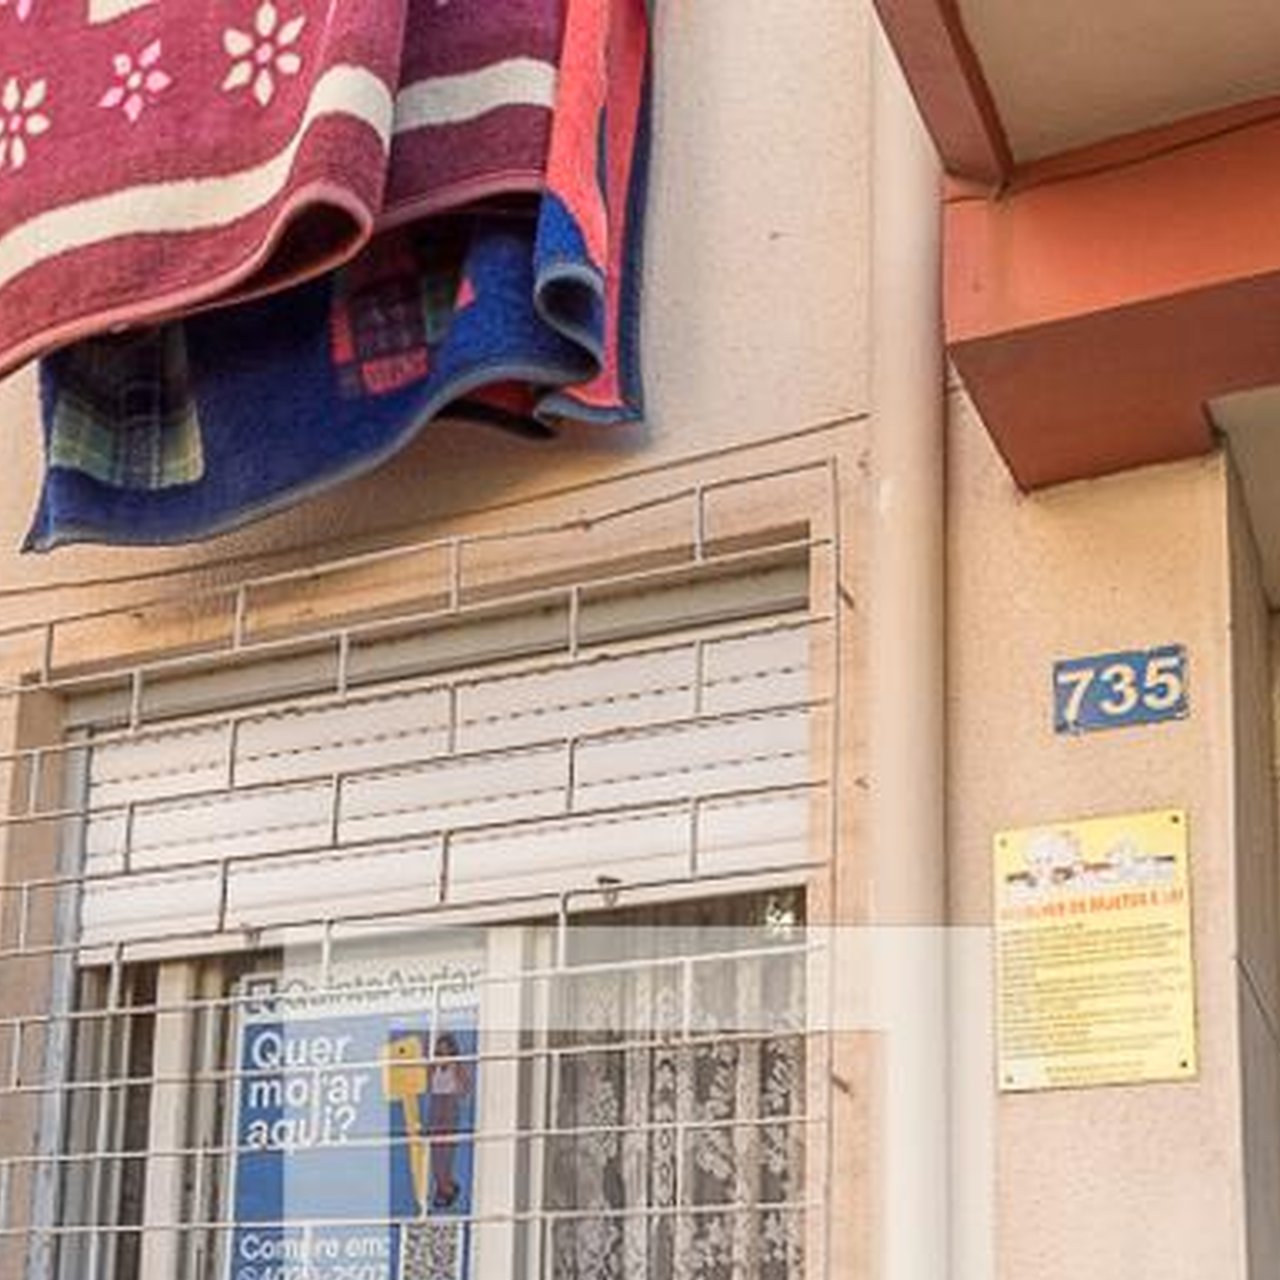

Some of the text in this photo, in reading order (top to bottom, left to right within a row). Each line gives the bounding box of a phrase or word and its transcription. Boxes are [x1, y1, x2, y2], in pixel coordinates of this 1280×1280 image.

[1056, 656, 1182, 722] 735
[251, 1031, 351, 1068] Quer
[246, 1104, 356, 1156] aqui?
[239, 1233, 339, 1265] Comre
